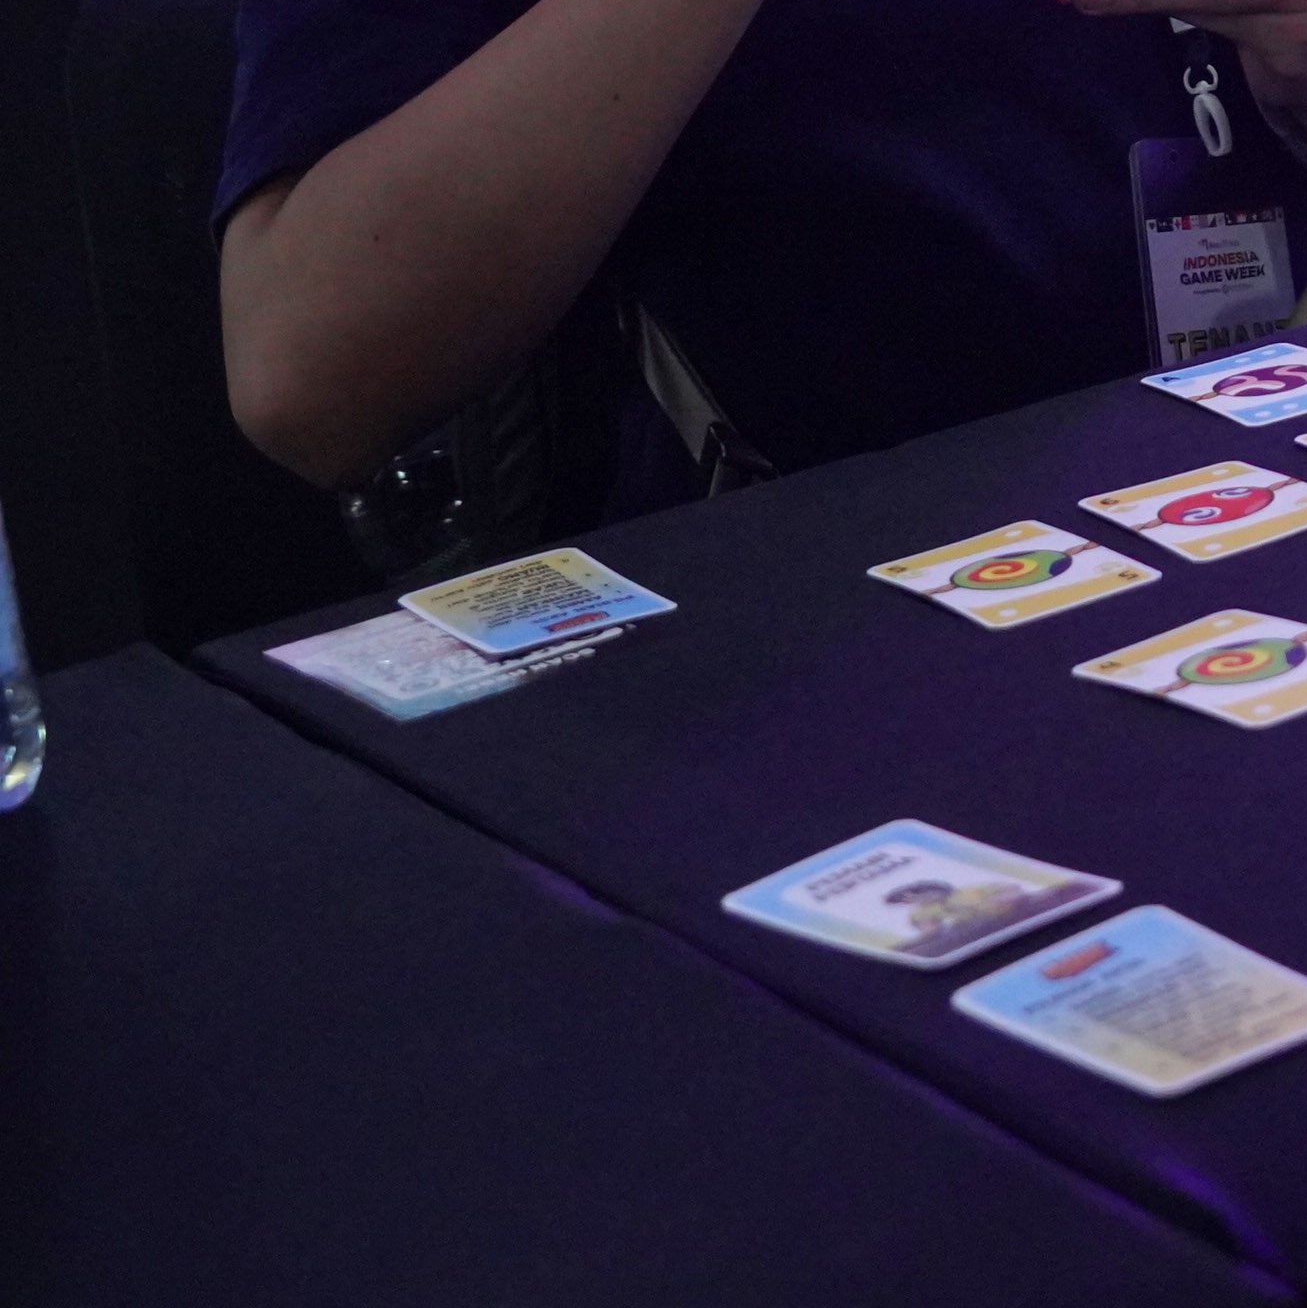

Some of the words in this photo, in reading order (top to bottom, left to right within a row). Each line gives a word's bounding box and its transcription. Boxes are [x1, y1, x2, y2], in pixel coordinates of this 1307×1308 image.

[1183, 251, 1259, 271] INDONESIA
[1180, 270, 1223, 285] GAME
[1225, 264, 1265, 281] WEEK
